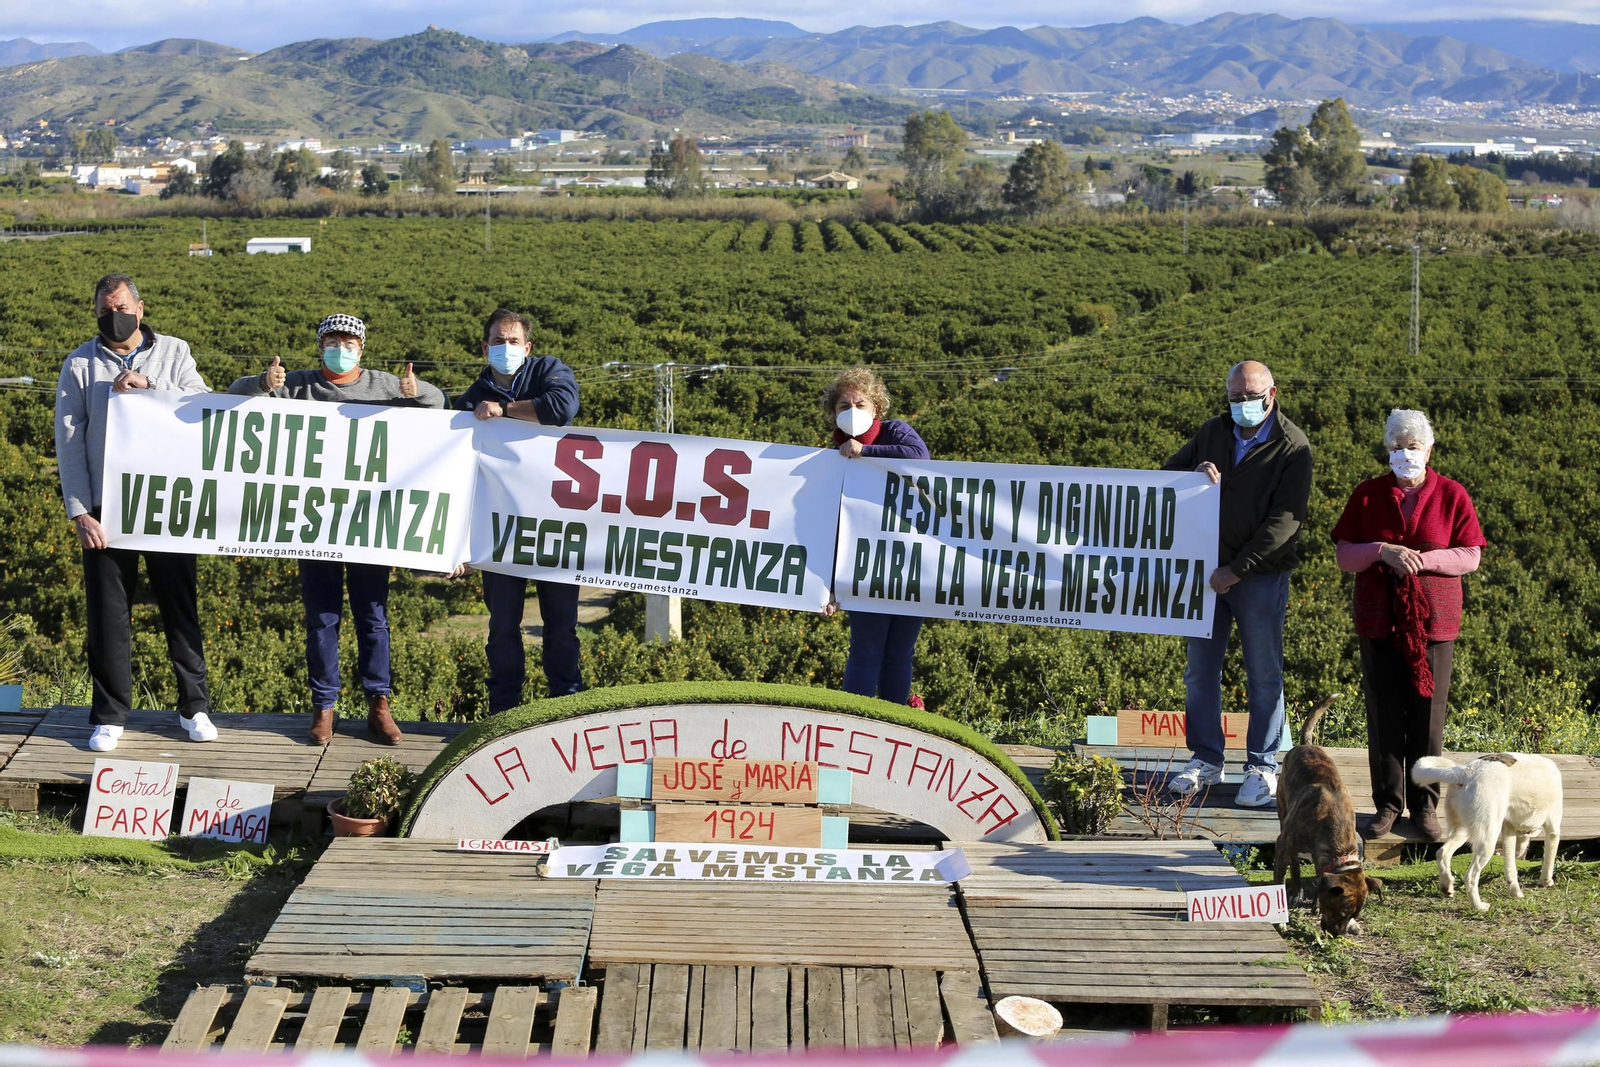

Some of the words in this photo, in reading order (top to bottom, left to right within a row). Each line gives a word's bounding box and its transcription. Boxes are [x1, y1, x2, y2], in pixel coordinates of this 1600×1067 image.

[201, 408, 327, 479] VISITE
[344, 418, 388, 483] LA
[550, 433, 771, 530] S.O.S.
[121, 472, 218, 540] VEGA
[238, 481, 451, 555] MESTANZA
[880, 471, 996, 541] RESPETO
[1010, 480, 1026, 543] Y
[1036, 481, 1177, 551] DIGINIDAD
[217, 545, 344, 559] #salvarvegamestanza
[491, 511, 588, 571] VEGA
[604, 525, 808, 596] MESTANZA
[574, 573, 699, 597] #salvarvegamestanza
[852, 537, 921, 602] PARA
[935, 544, 966, 606] LA
[981, 548, 1046, 611] VEGA
[1059, 554, 1205, 621] MESTANZA
[954, 609, 1082, 626] #salvarvegamestanza
[1141, 712, 1237, 738] MANL
[96, 765, 173, 797] Central
[465, 746, 531, 806] LA
[551, 718, 678, 774] VEGA
[711, 718, 749, 760] de
[781, 721, 1019, 836] MESTANZA
[663, 760, 725, 790] JOSÉ
[731, 780, 743, 800] y
[745, 761, 813, 791] MARÍA
[216, 784, 244, 811] de
[95, 804, 170, 838] PARK
[189, 807, 267, 844] MÁLAGA
[704, 808, 775, 841] 1924
[566, 861, 676, 877] VEGA
[701, 864, 946, 882] MESTANZA
[603, 846, 838, 868] SALVEMOS
[863, 854, 911, 868] LA
[1191, 891, 1271, 922] AUXILIO
